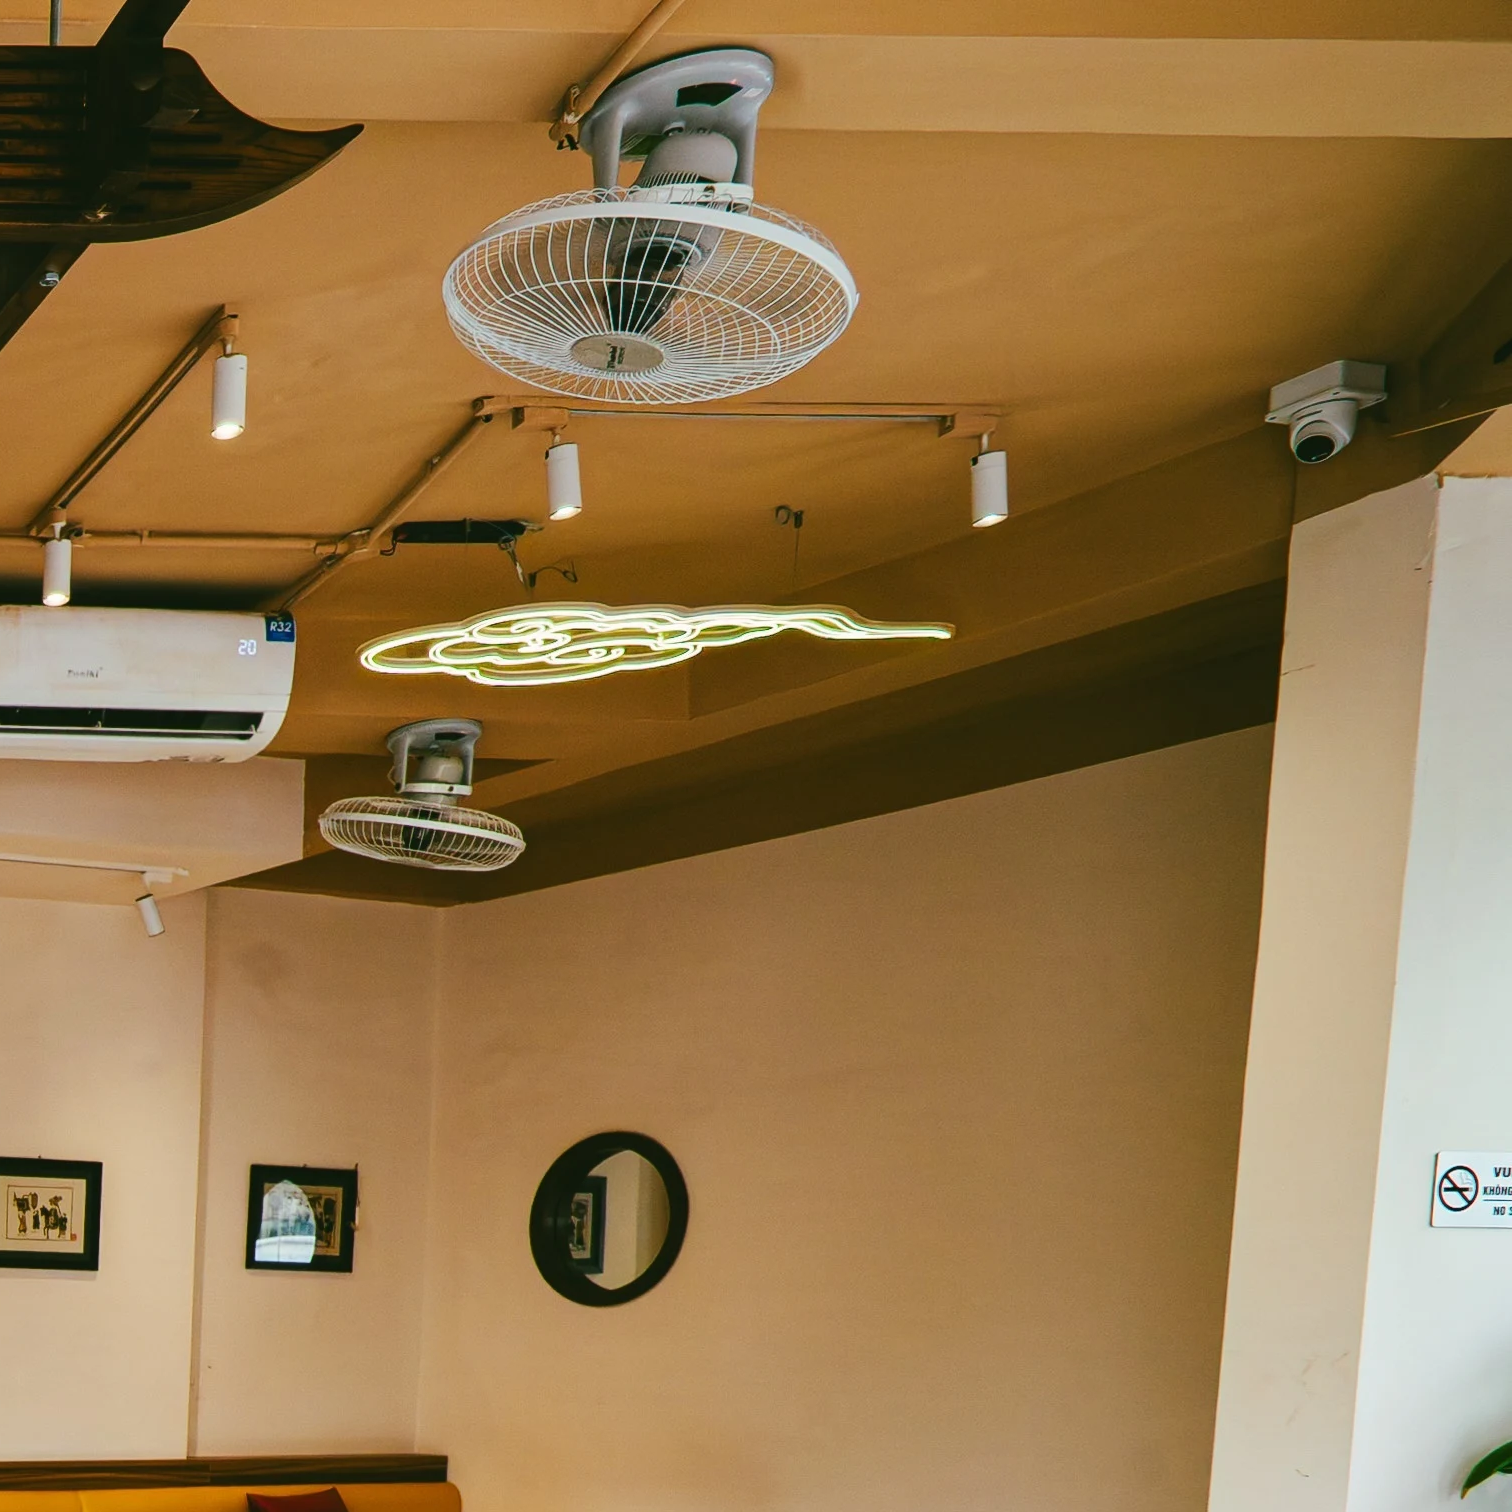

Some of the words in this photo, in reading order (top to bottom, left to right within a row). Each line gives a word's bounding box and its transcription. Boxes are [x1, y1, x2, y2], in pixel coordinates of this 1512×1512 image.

[270, 621, 292, 633] R32
[238, 639, 257, 656] 20
[1494, 1166, 1512, 1178] VU
[1493, 1206, 1506, 1216] NO
